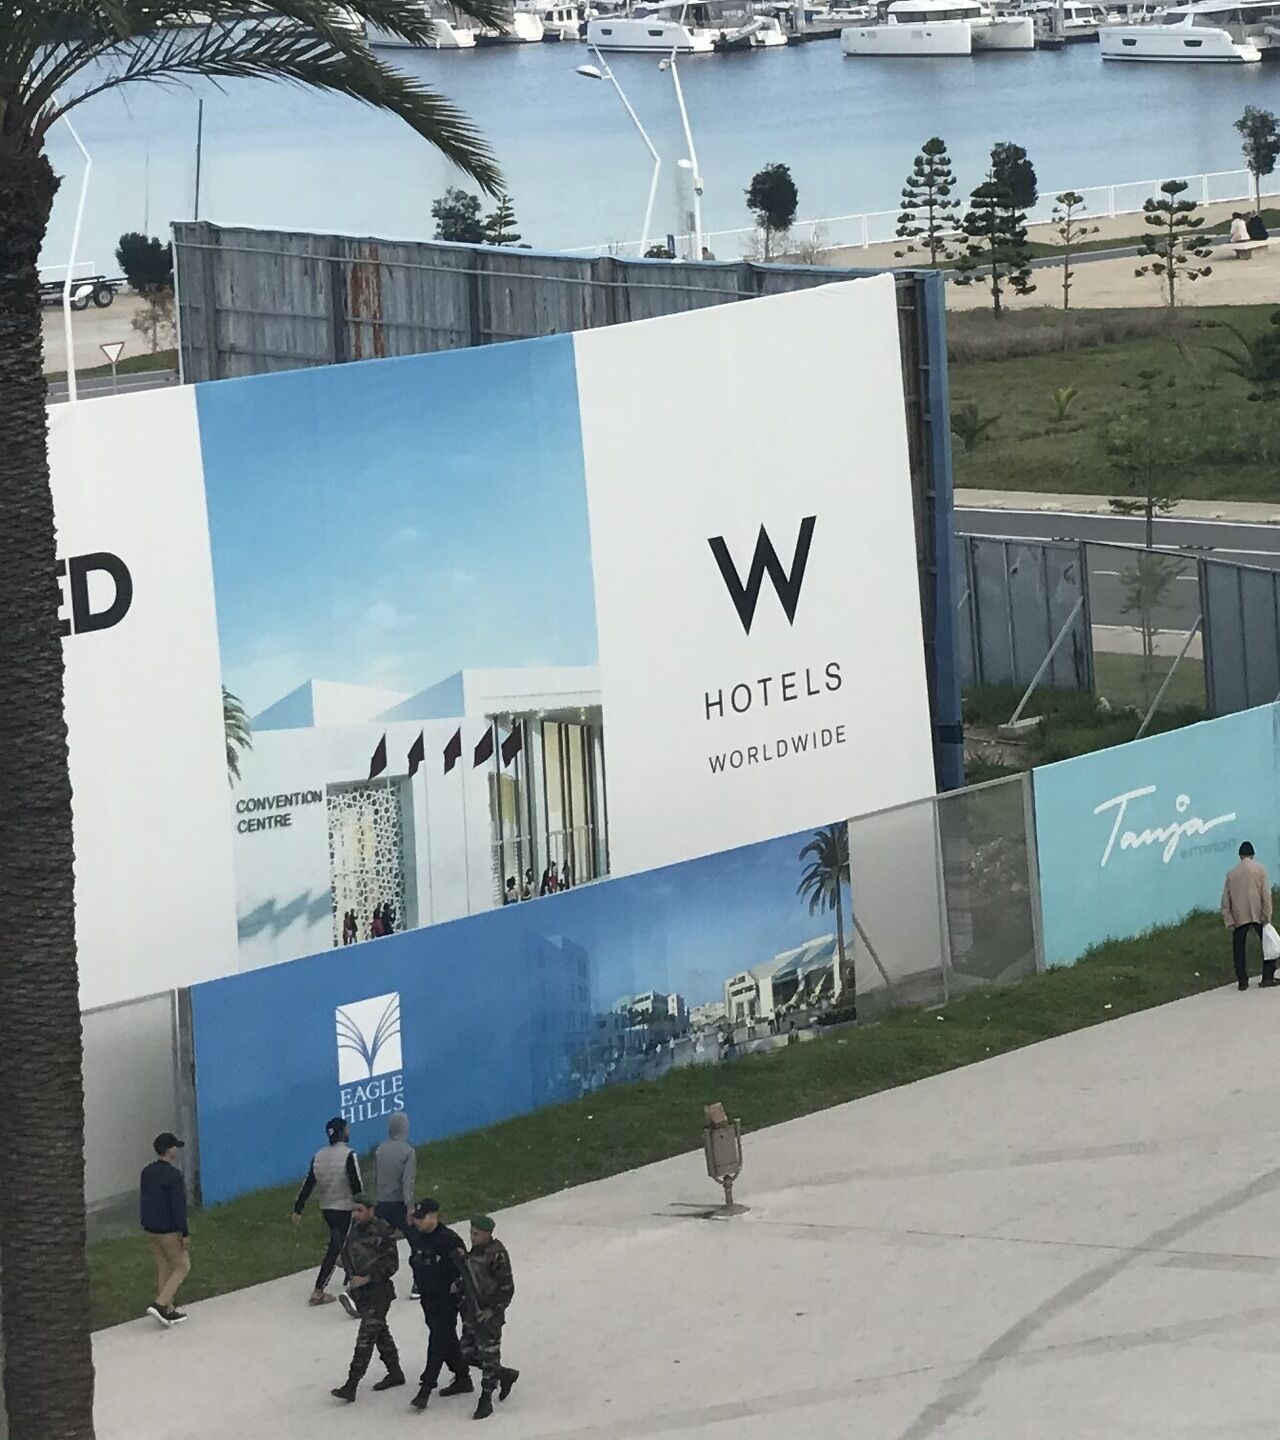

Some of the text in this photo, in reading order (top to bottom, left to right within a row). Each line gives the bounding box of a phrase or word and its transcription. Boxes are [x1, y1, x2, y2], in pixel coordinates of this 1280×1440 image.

[707, 515, 817, 637] W
[704, 661, 844, 721] HOTELS
[708, 723, 848, 774] WORLDWIDE
[235, 790, 323, 814] CONVENTION
[236, 813, 293, 834] CENTRE
[340, 1075, 405, 1106] EAGLE
[340, 1093, 405, 1124] HILLS
